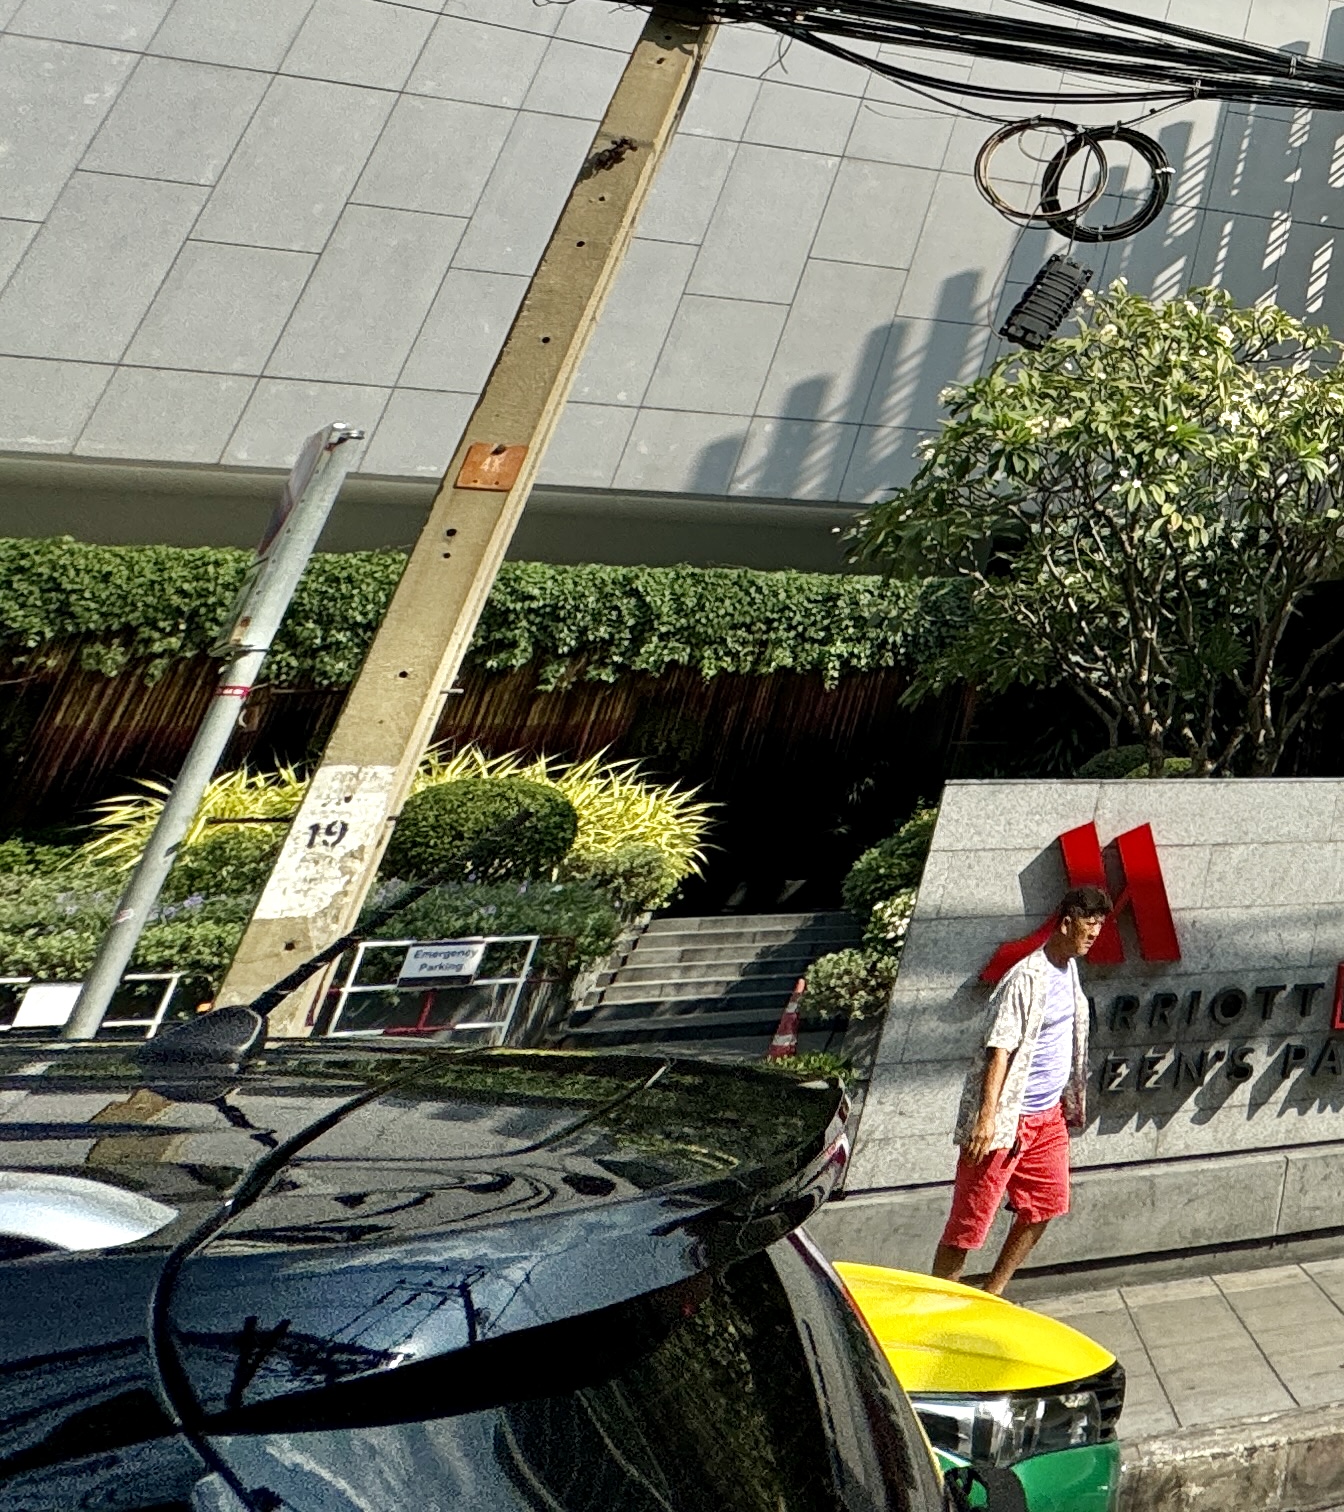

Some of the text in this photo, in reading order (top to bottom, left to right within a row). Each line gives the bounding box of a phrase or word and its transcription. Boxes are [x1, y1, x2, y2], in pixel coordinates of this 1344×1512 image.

[306, 819, 349, 849] 19
[414, 949, 479, 960] Emergency
[419, 962, 464, 973] Parking
